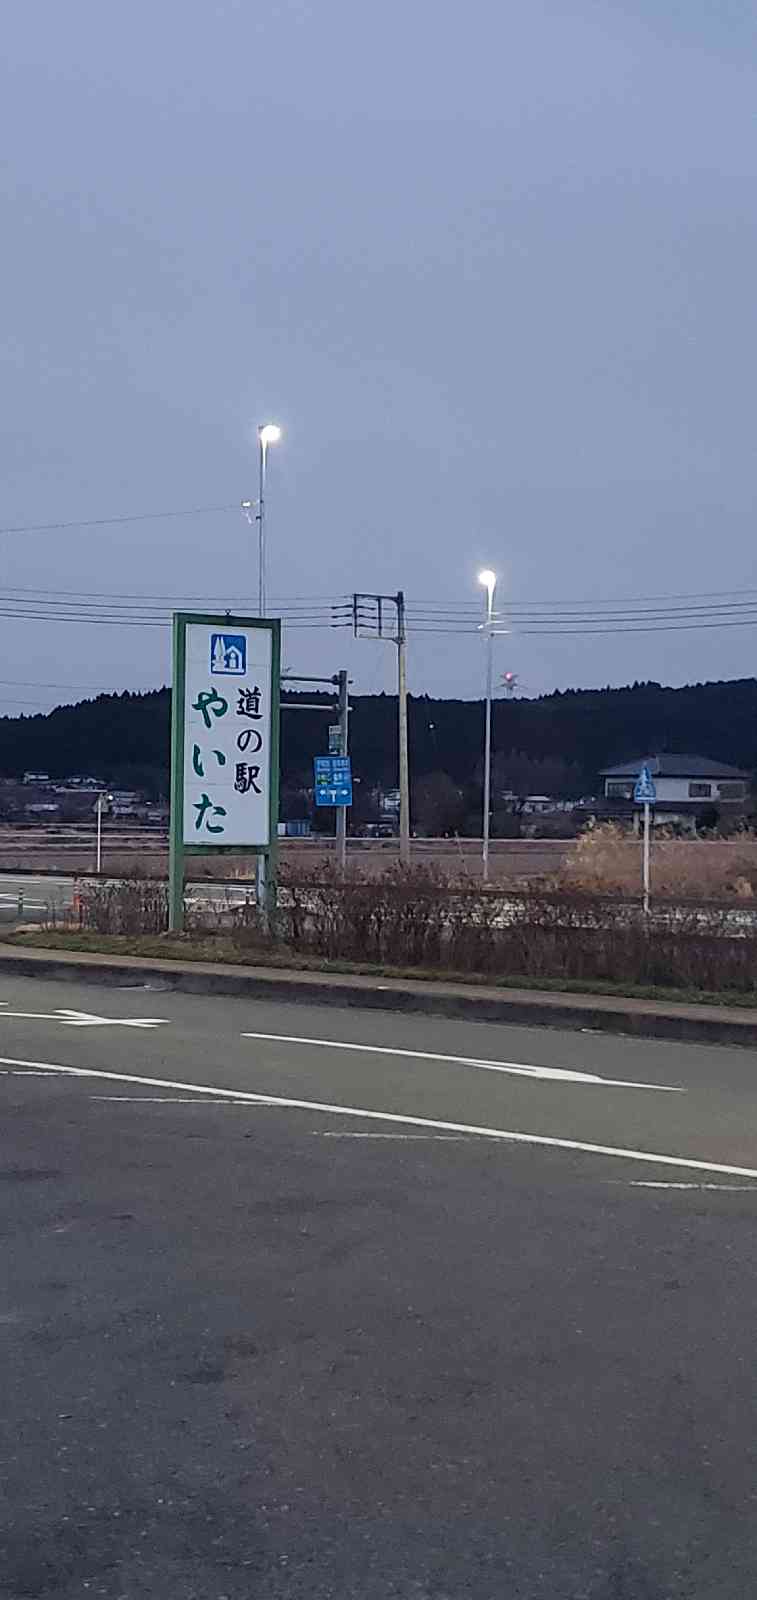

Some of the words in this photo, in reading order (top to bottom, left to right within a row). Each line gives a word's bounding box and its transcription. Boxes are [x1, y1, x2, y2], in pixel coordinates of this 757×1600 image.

[192, 687, 228, 833] やいた
[234, 686, 263, 794] 道の駅
